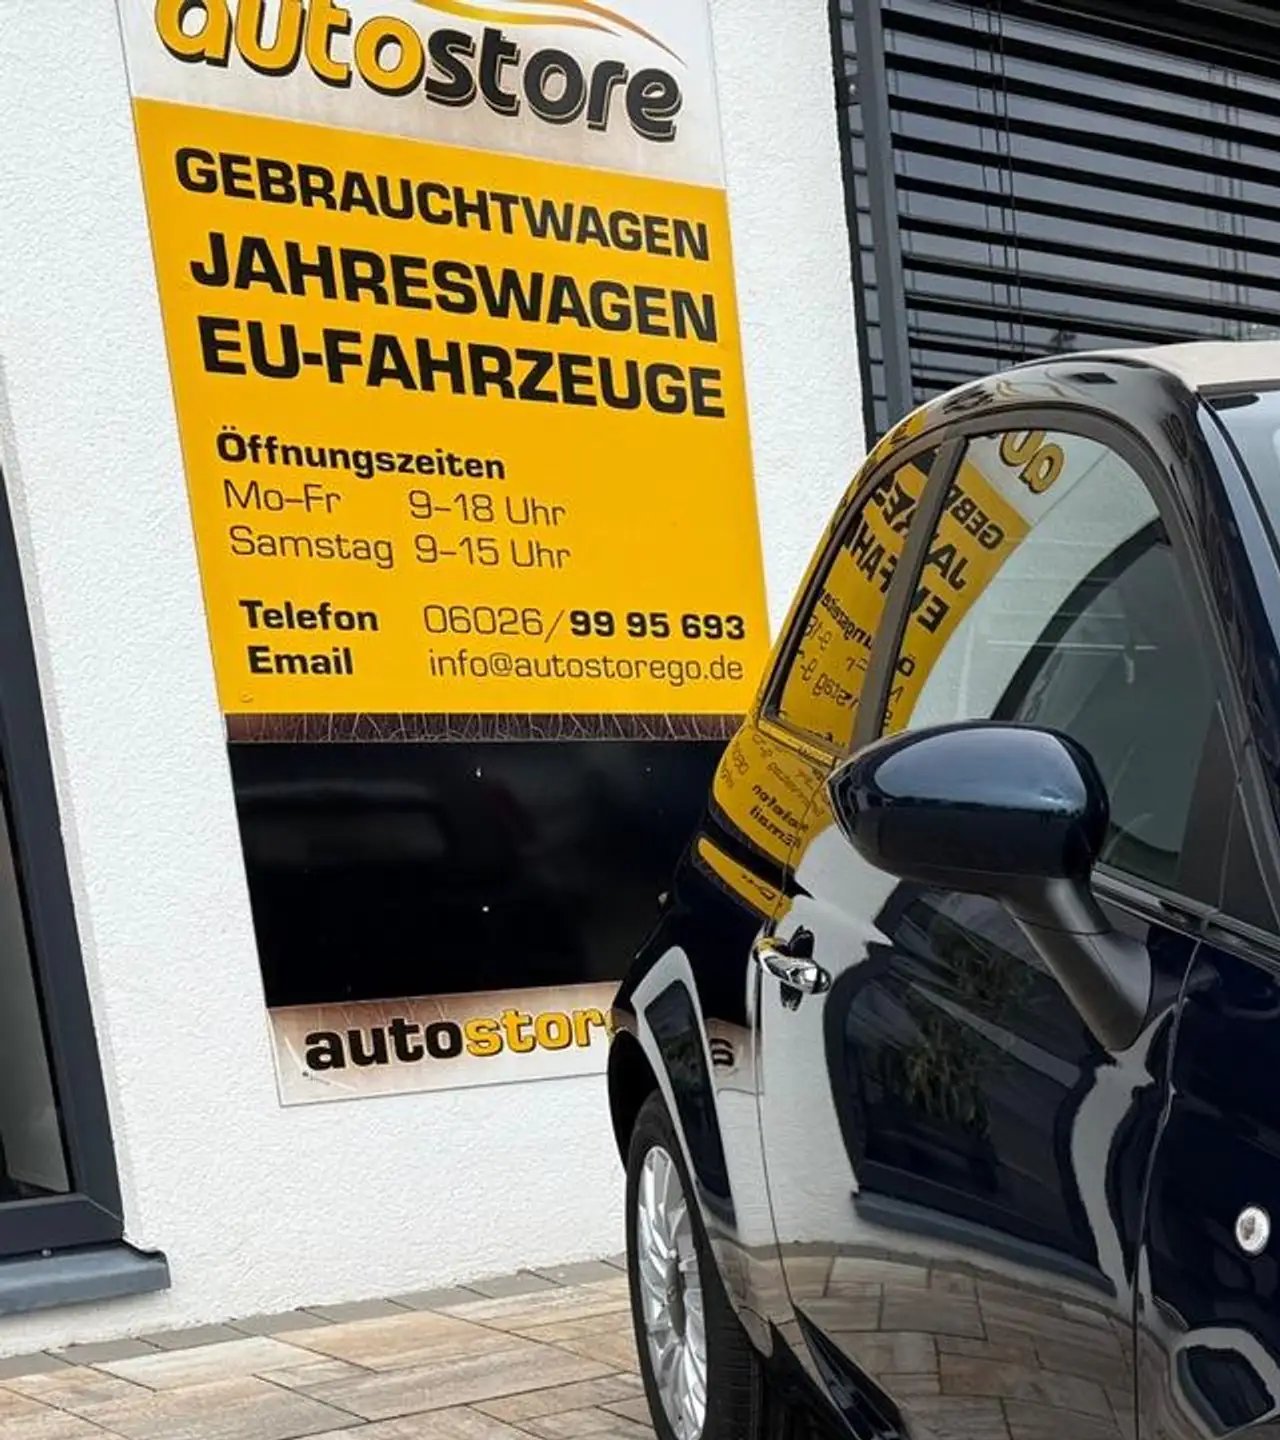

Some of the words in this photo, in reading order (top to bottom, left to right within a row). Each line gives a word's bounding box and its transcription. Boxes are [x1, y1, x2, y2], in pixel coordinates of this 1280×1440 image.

[174, 148, 710, 261] GEBRAUCHTWAGEN
[190, 232, 719, 343] JAHRESWAGEN
[198, 316, 726, 419] EU-FAHRZEUGE
[216, 426, 506, 481] Öffnungszeiten
[224, 480, 341, 515] Mo-Fr
[409, 490, 494, 524] 9-18
[505, 496, 566, 528] Uhr
[229, 527, 395, 569] Samstag
[414, 535, 500, 567] 9-15
[511, 540, 571, 571] Uhr
[239, 600, 379, 633] Telefon
[626, 612, 671, 641] 95
[681, 612, 746, 641] 693
[248, 645, 354, 677] Email
[430, 649, 745, 685] info@autostorego.de
